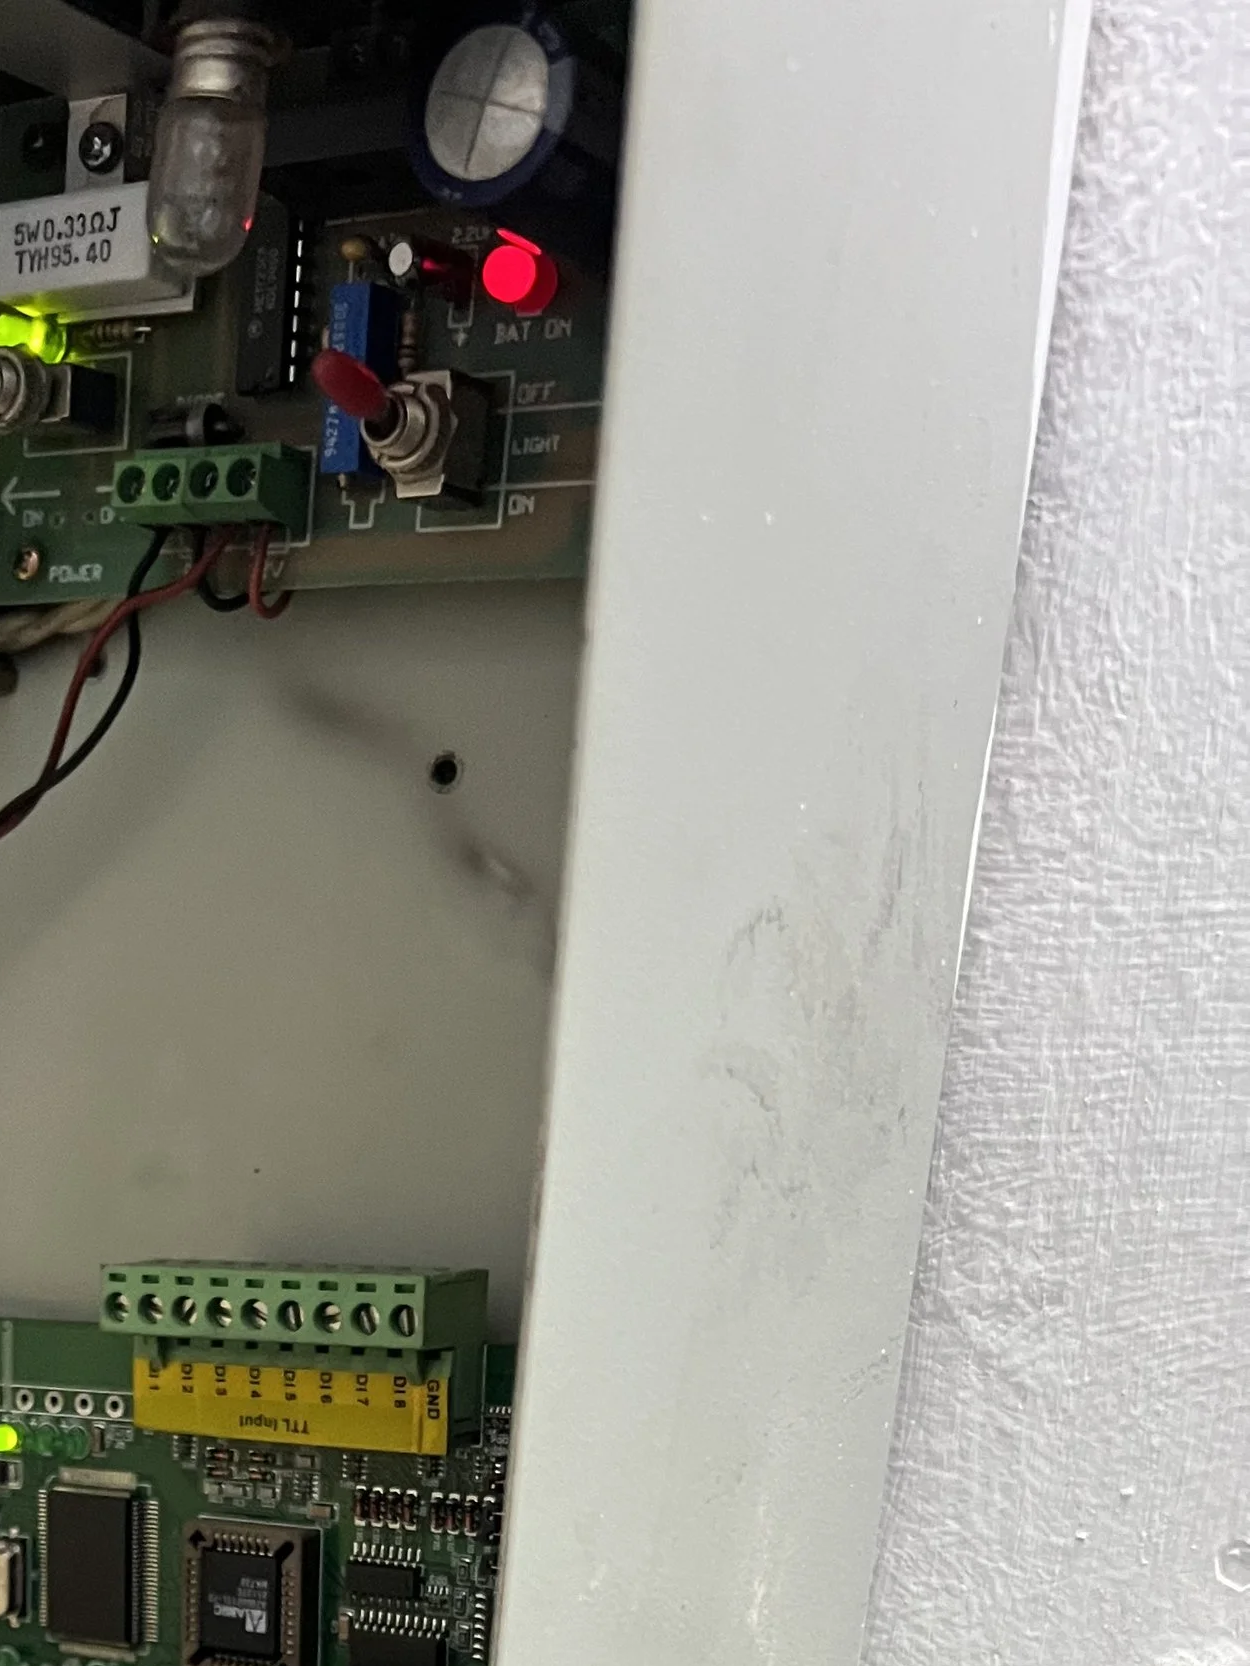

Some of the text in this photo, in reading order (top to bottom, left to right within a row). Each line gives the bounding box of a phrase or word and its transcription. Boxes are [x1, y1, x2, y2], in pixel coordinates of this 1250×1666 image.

[494, 321, 532, 344] BAT
[512, 434, 560, 456] LIGHT
[508, 494, 535, 516] ON
[426, 1379, 440, 1420] GND
[238, 1413, 310, 1434] TTL Input
